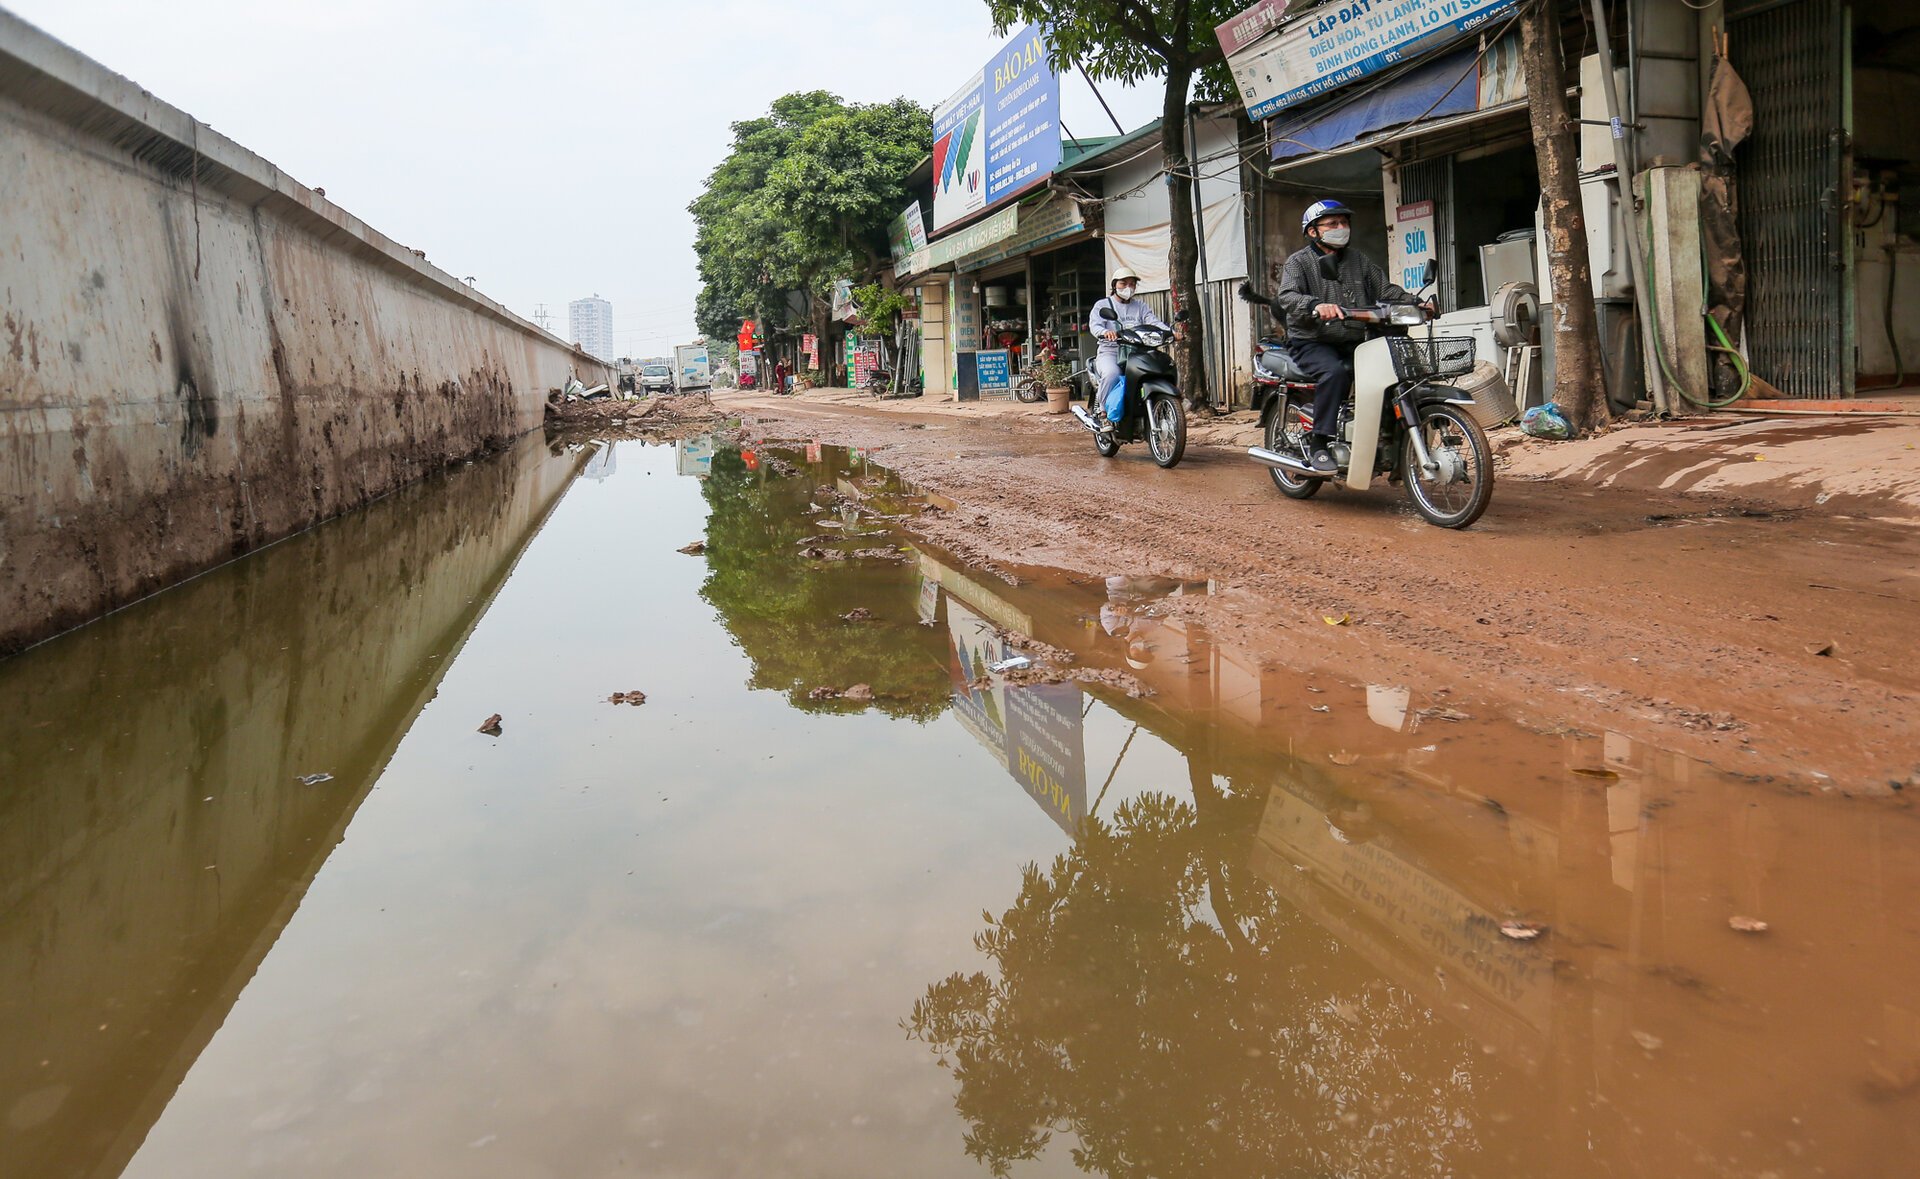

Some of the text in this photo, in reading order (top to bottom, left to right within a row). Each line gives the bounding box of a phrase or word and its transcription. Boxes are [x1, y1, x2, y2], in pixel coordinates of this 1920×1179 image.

[1441, 1, 1458, 17] VI
[1023, 34, 1042, 72] AN
[1405, 226, 1427, 254] SỬA
